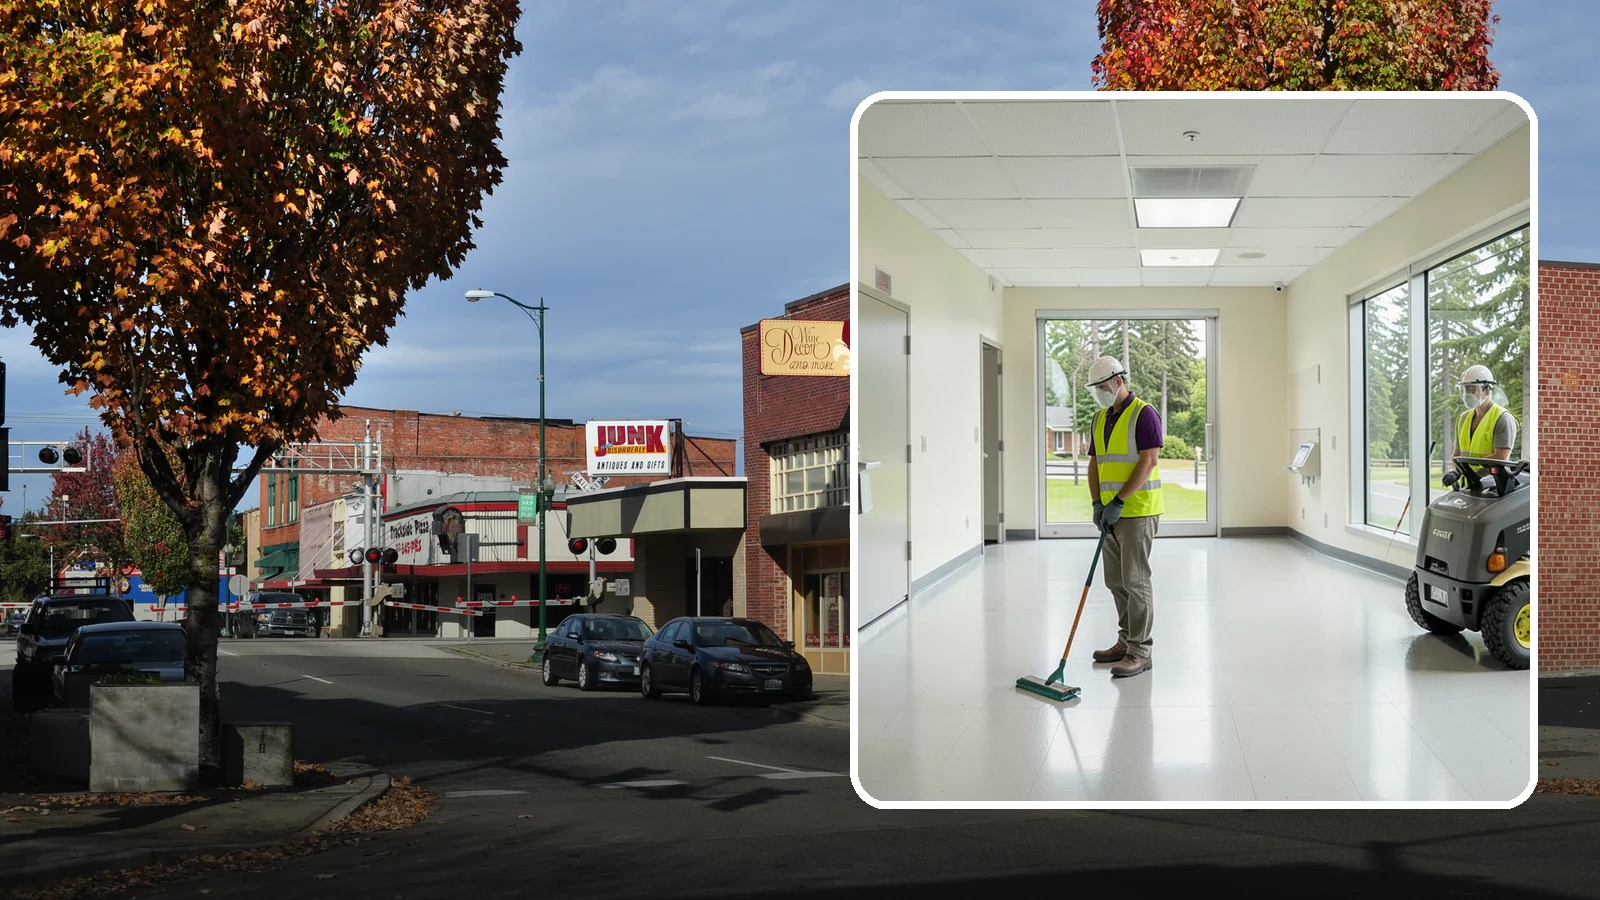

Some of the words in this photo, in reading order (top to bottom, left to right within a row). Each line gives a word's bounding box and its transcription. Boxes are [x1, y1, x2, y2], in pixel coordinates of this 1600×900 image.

[595, 425, 664, 457] JUNK
[607, 446, 645, 454] DISORDERLY
[597, 461, 628, 470] ANTIQUES
[631, 461, 644, 470] AND
[647, 461, 665, 470] GIFTS
[573, 473, 588, 491] RAIL
[390, 521, 413, 539] Trackside
[414, 519, 429, 535] Pizza
